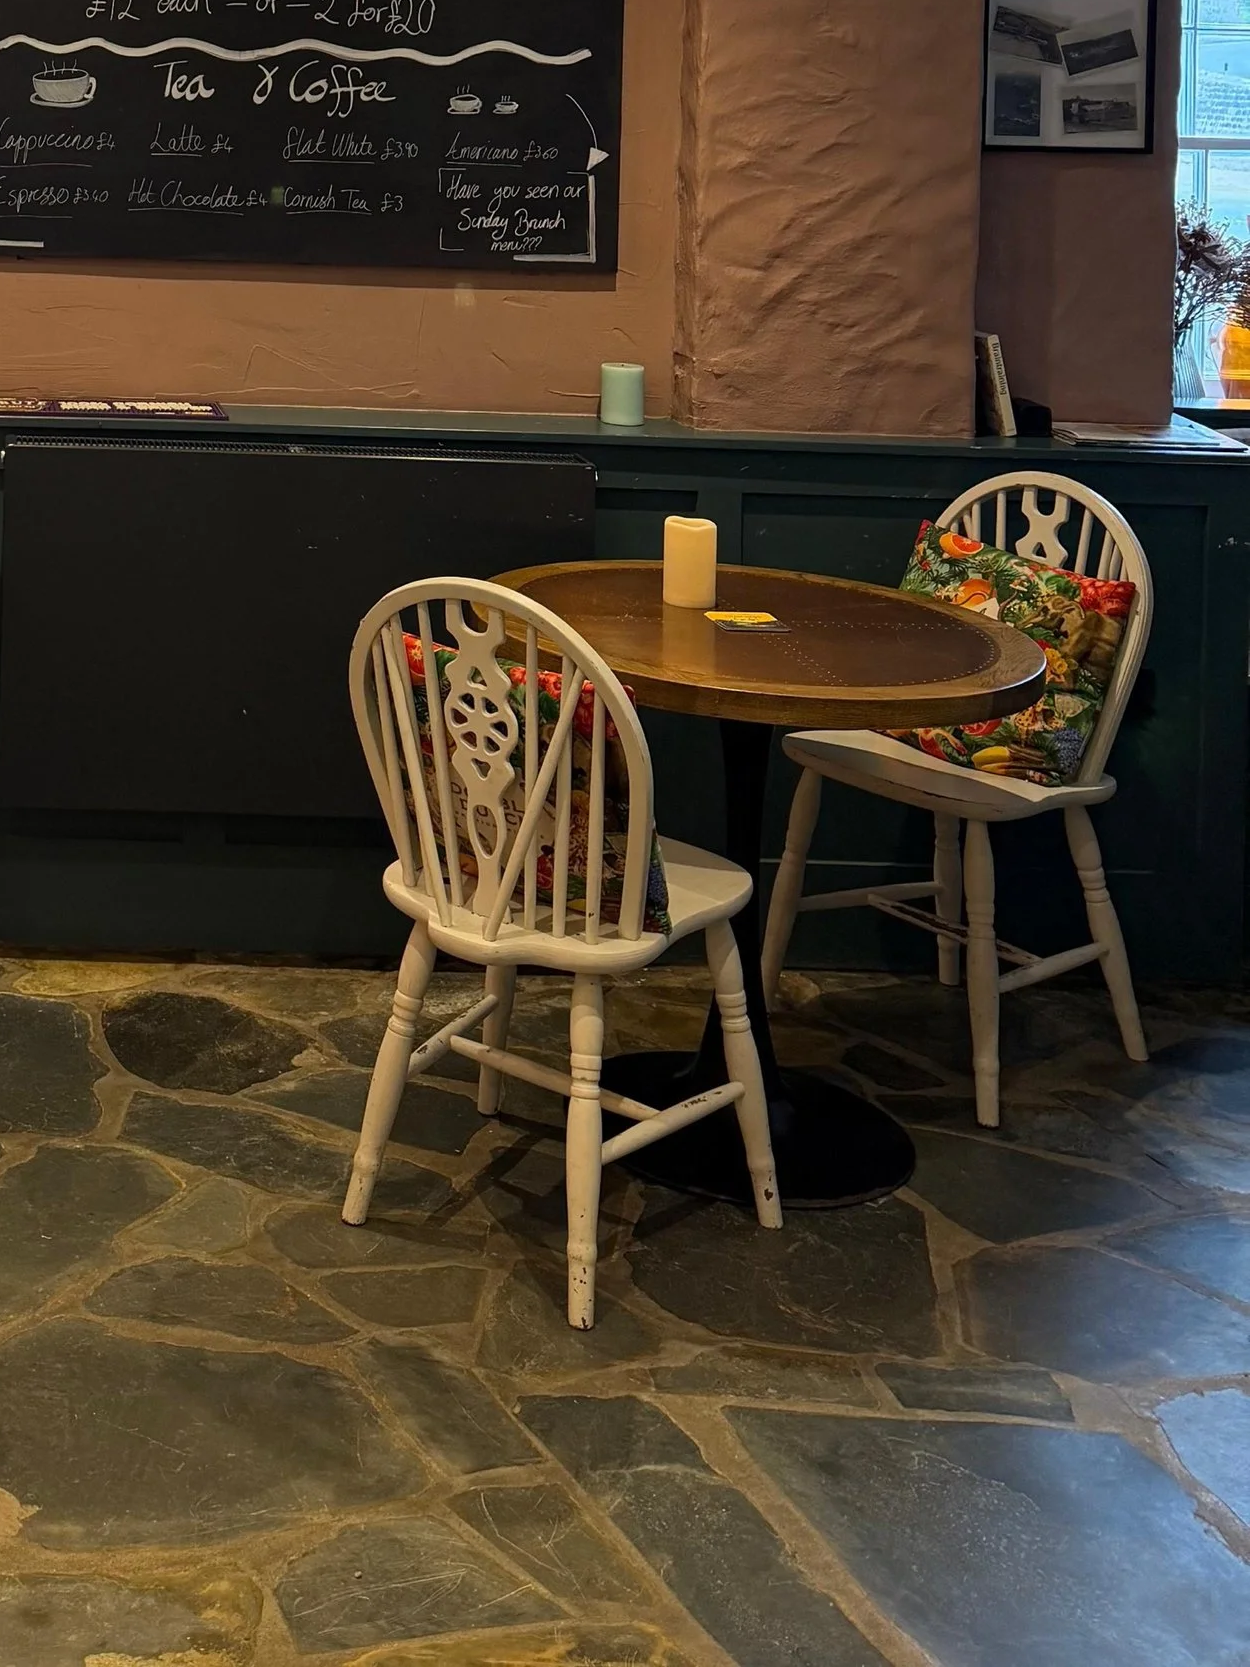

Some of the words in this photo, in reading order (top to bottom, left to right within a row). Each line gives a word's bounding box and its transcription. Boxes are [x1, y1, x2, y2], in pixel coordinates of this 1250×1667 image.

[153, 60, 216, 101] Tea
[289, 60, 398, 118] Coffee
[96, 131, 116, 151] £4
[150, 122, 206, 153] Latte
[210, 134, 234, 153] £4
[331, 131, 378, 158] White
[444, 131, 519, 160] Americano
[127, 177, 157, 204] Hot
[159, 179, 246, 209] Chocolate
[245, 189, 268, 207] £4
[283, 184, 336, 210] Cornish
[340, 188, 372, 212] Tea
[380, 191, 404, 212] £3
[445, 174, 482, 200] Have
[487, 185, 521, 213] you
[524, 184, 560, 200] seen
[563, 184, 586, 199] our
[457, 207, 509, 241] Sunday
[513, 207, 567, 236] Brunch
[490, 235, 543, 252] menu???
[992, 342, 1007, 395] Braintraining
